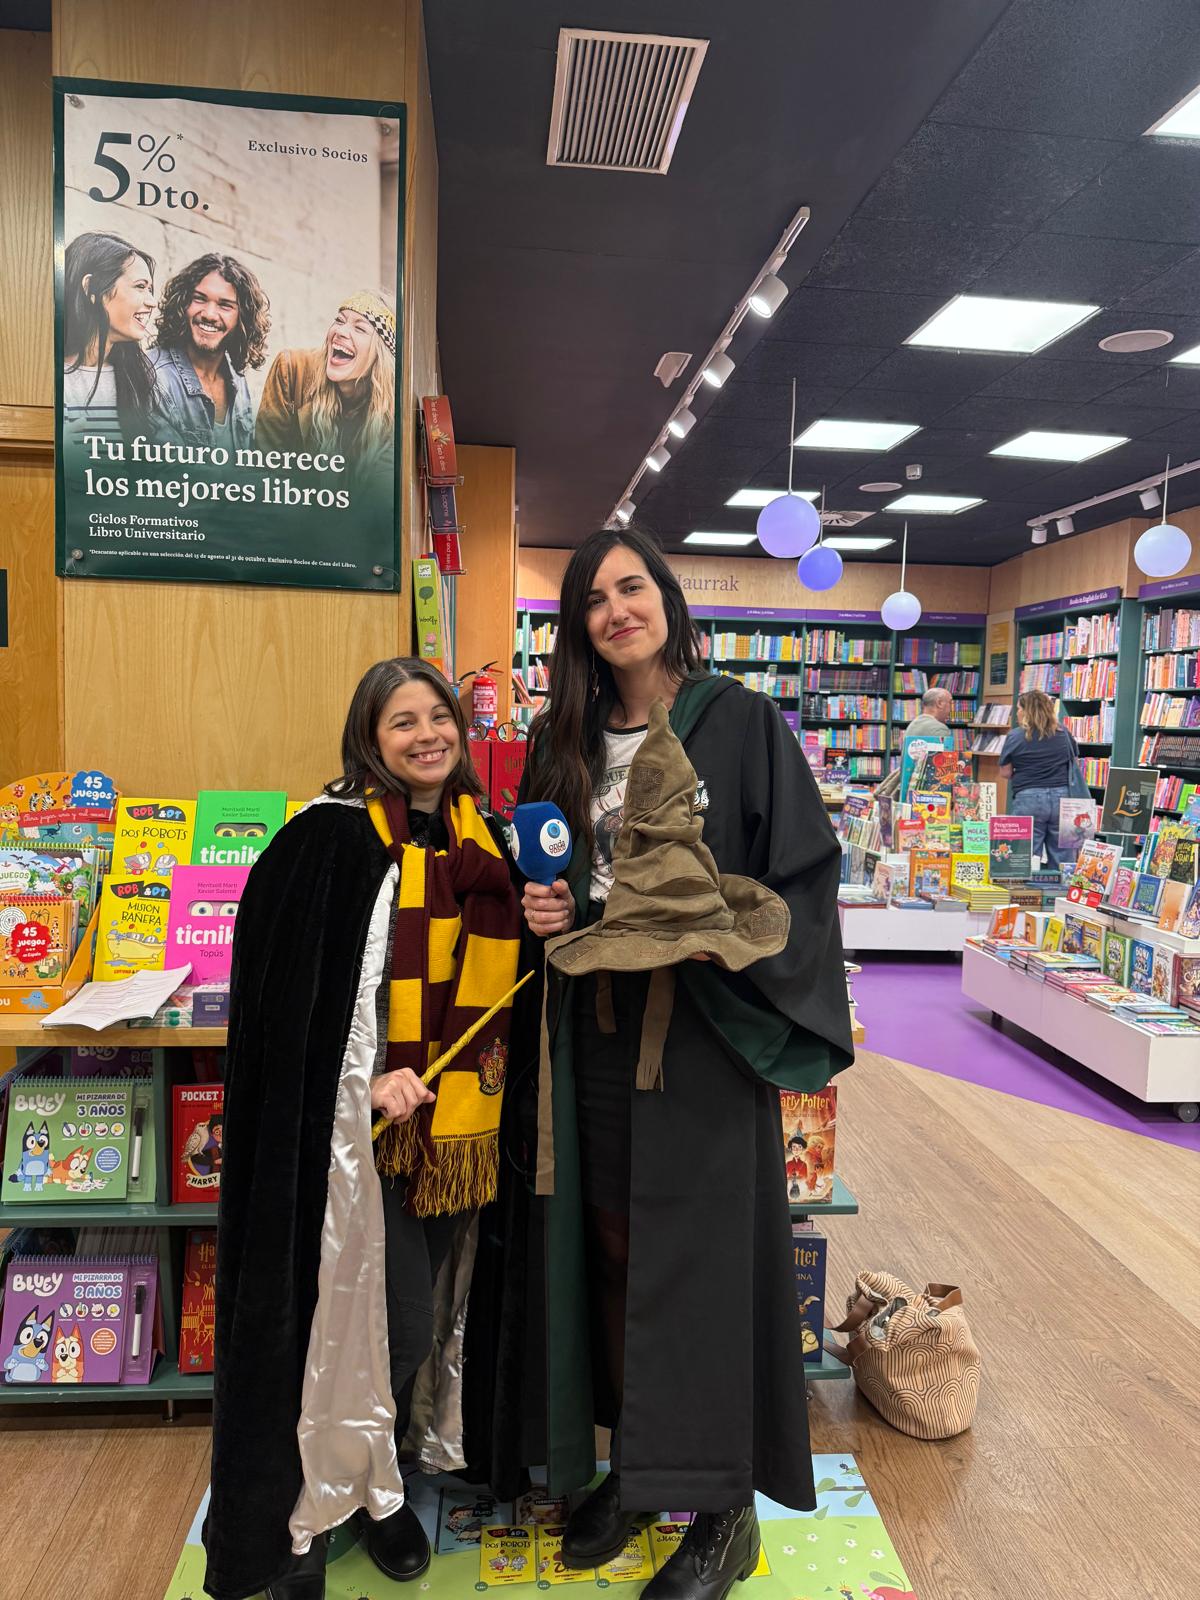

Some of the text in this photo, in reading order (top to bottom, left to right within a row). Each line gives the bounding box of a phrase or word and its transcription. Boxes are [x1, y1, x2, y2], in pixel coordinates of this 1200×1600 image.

[248, 140, 368, 164] Exclusivo Socios
[136, 181, 210, 211] Dto.
[84, 435, 345, 473] Tu futuro merece
[84, 469, 350, 509] los mejores libros
[88, 513, 199, 528] Ciclos Formativos
[89, 526, 206, 541] Libro Universitario
[83, 775, 103, 789] 45
[133, 806, 153, 817] ROB
[121, 829, 140, 839] DOS
[142, 827, 189, 840] ROBOTS
[548, 840, 566, 851] onda
[0, 871, 30, 880] JUEGOS
[117, 883, 139, 897] ROB
[121, 911, 162, 926] BAÑERA
[22, 926, 38, 937] 45
[16, 938, 46, 948] juegos
[181, 1091, 219, 1101] POCKET
[781, 1093, 831, 1111] arry Potter
[14, 1092, 66, 1117] BLUEY
[78, 1103, 125, 1116] 3 AÑOS
[191, 1175, 218, 1185] HARRY
[794, 1247, 819, 1267] tter
[12, 1272, 63, 1297] BLUEY
[75, 1284, 121, 1297] 2 AÑOS
[500, 1540, 531, 1549] ROBOTS
